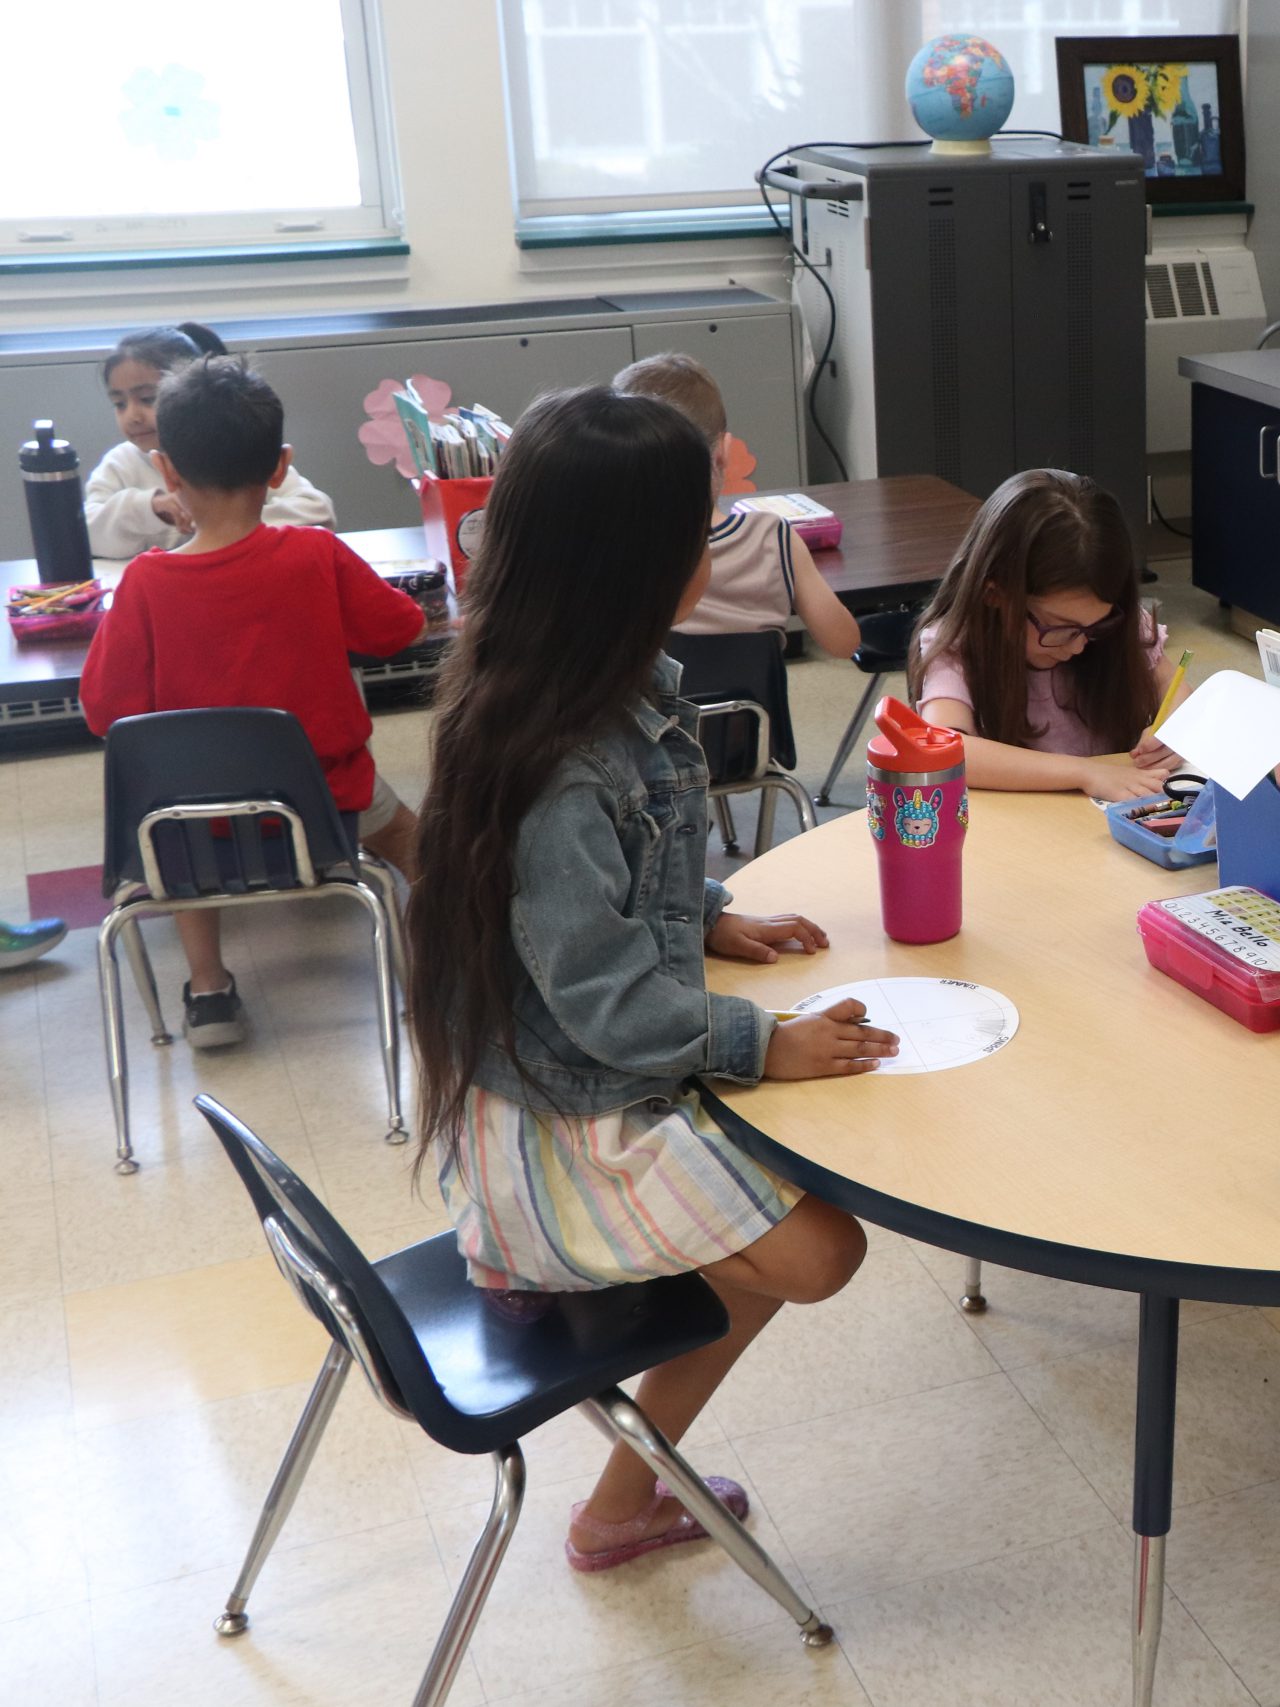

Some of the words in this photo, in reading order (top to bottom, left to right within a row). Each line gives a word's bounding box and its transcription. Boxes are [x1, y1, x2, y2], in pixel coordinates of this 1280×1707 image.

[1205, 910, 1232, 925] Mia
[1231, 926, 1270, 947] Bello
[1252, 957, 1268, 966] 10
